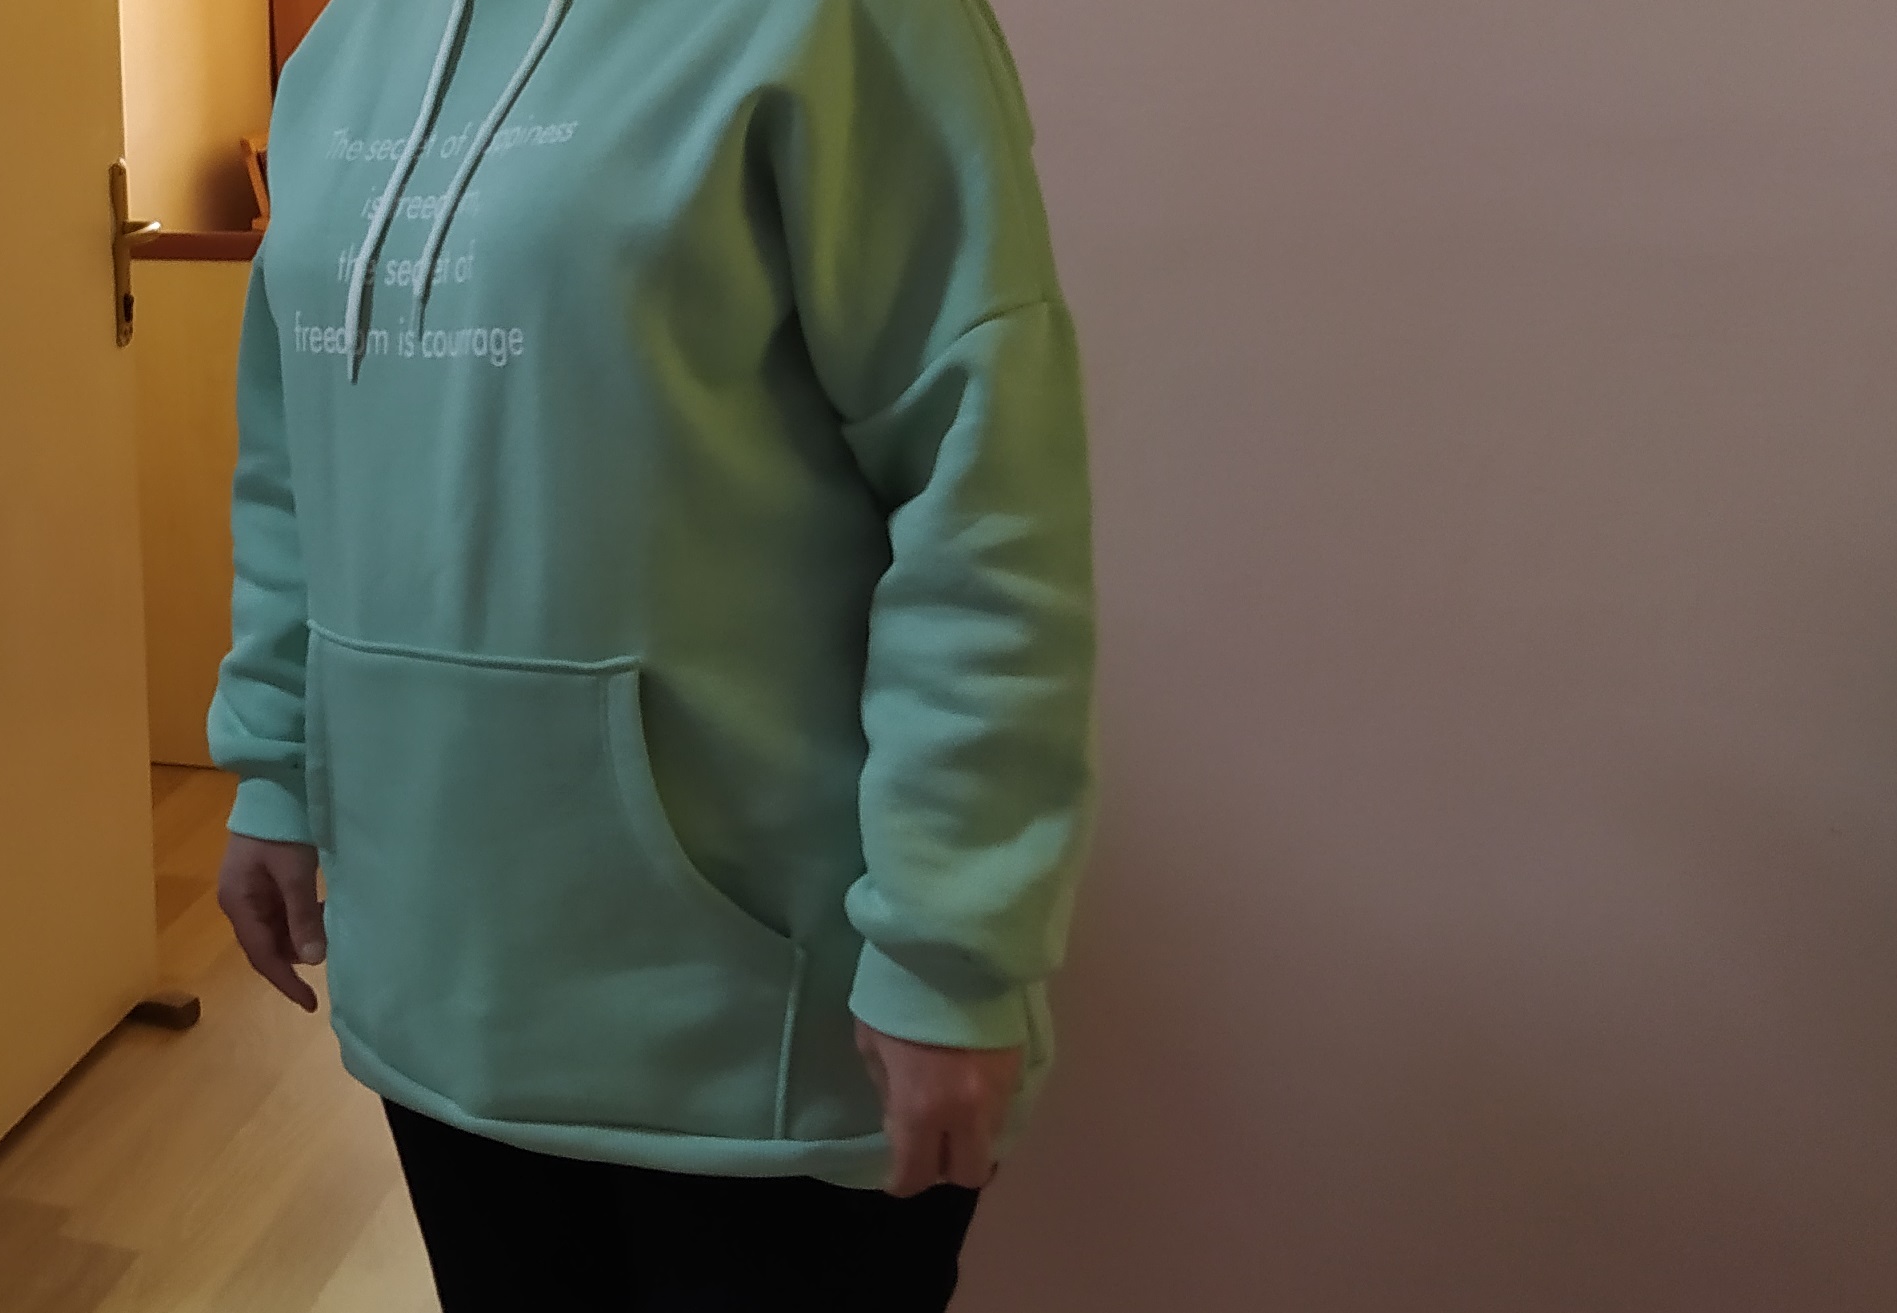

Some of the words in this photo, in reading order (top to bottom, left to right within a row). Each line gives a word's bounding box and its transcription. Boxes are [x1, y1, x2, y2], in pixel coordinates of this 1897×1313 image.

[325, 127, 363, 161] The
[364, 131, 438, 161] sect
[440, 121, 472, 159] of
[337, 243, 375, 285] th
[383, 251, 450, 287] seet
[294, 310, 389, 356] freedm
[397, 316, 415, 358] is
[421, 326, 524, 367] courage
